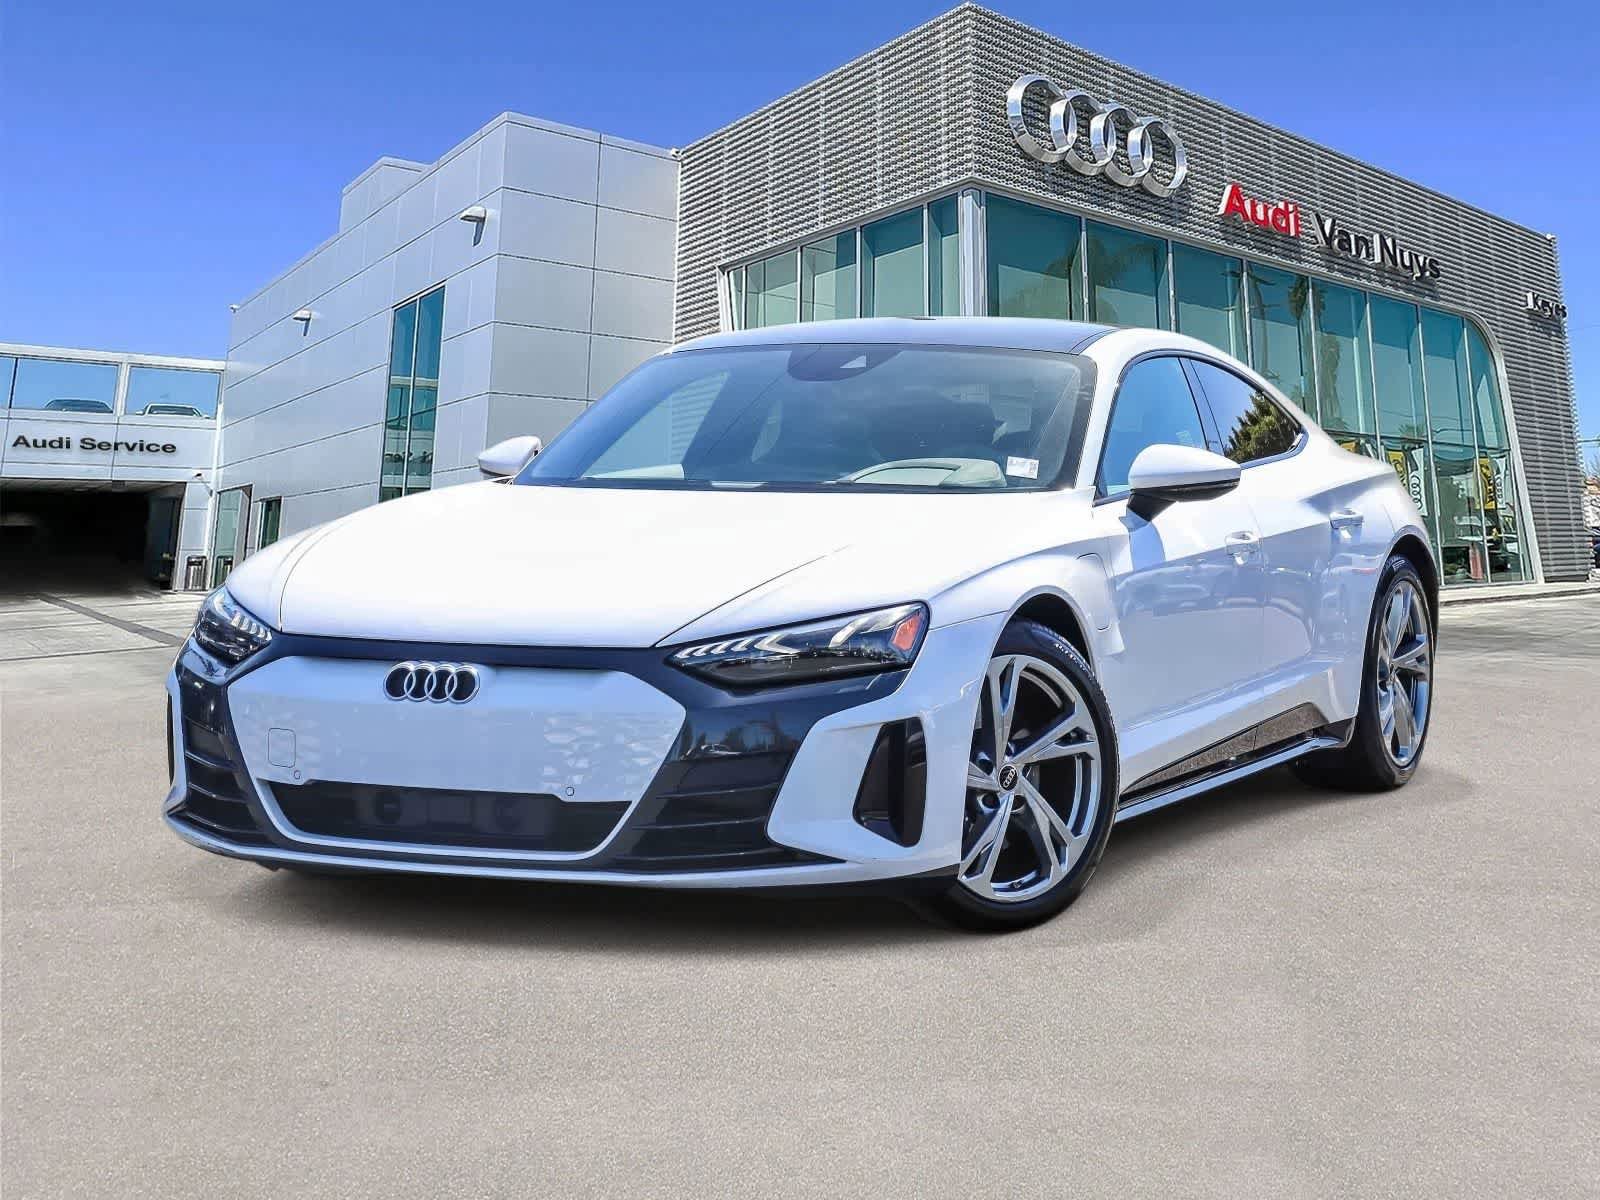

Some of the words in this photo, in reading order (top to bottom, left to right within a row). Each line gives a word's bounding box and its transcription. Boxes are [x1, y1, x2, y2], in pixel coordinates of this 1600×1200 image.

[1217, 183, 1302, 237] Audi
[1311, 211, 1370, 257] Van
[1373, 233, 1441, 280] Nuys
[12, 435, 71, 449] Audi
[79, 437, 177, 453] Service
